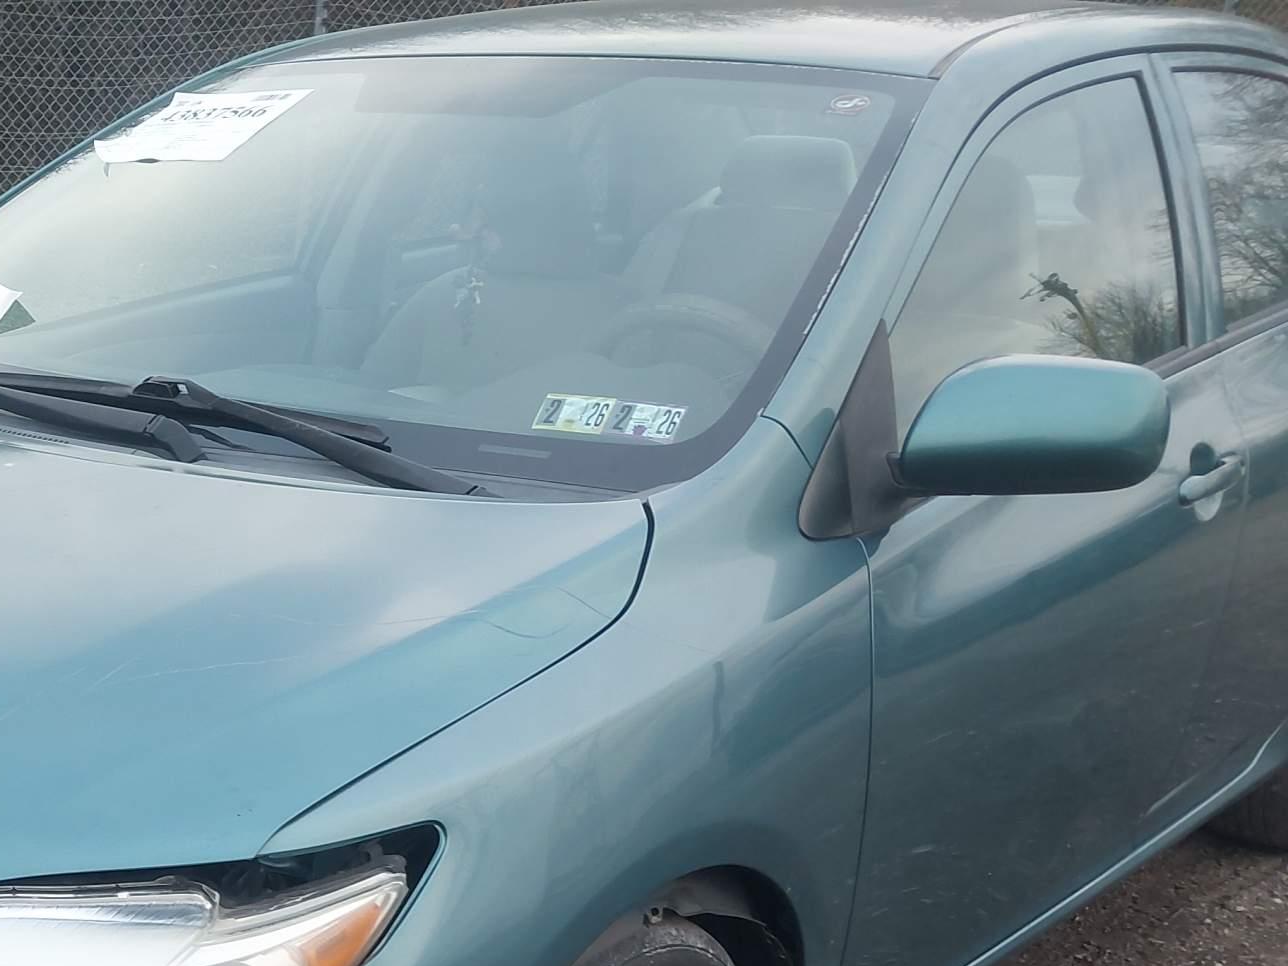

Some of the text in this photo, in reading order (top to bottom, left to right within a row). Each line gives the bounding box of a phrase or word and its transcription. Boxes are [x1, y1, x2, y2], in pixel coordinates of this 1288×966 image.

[161, 104, 274, 122] 43837566
[585, 402, 610, 428] 26
[656, 409, 682, 436] 26
